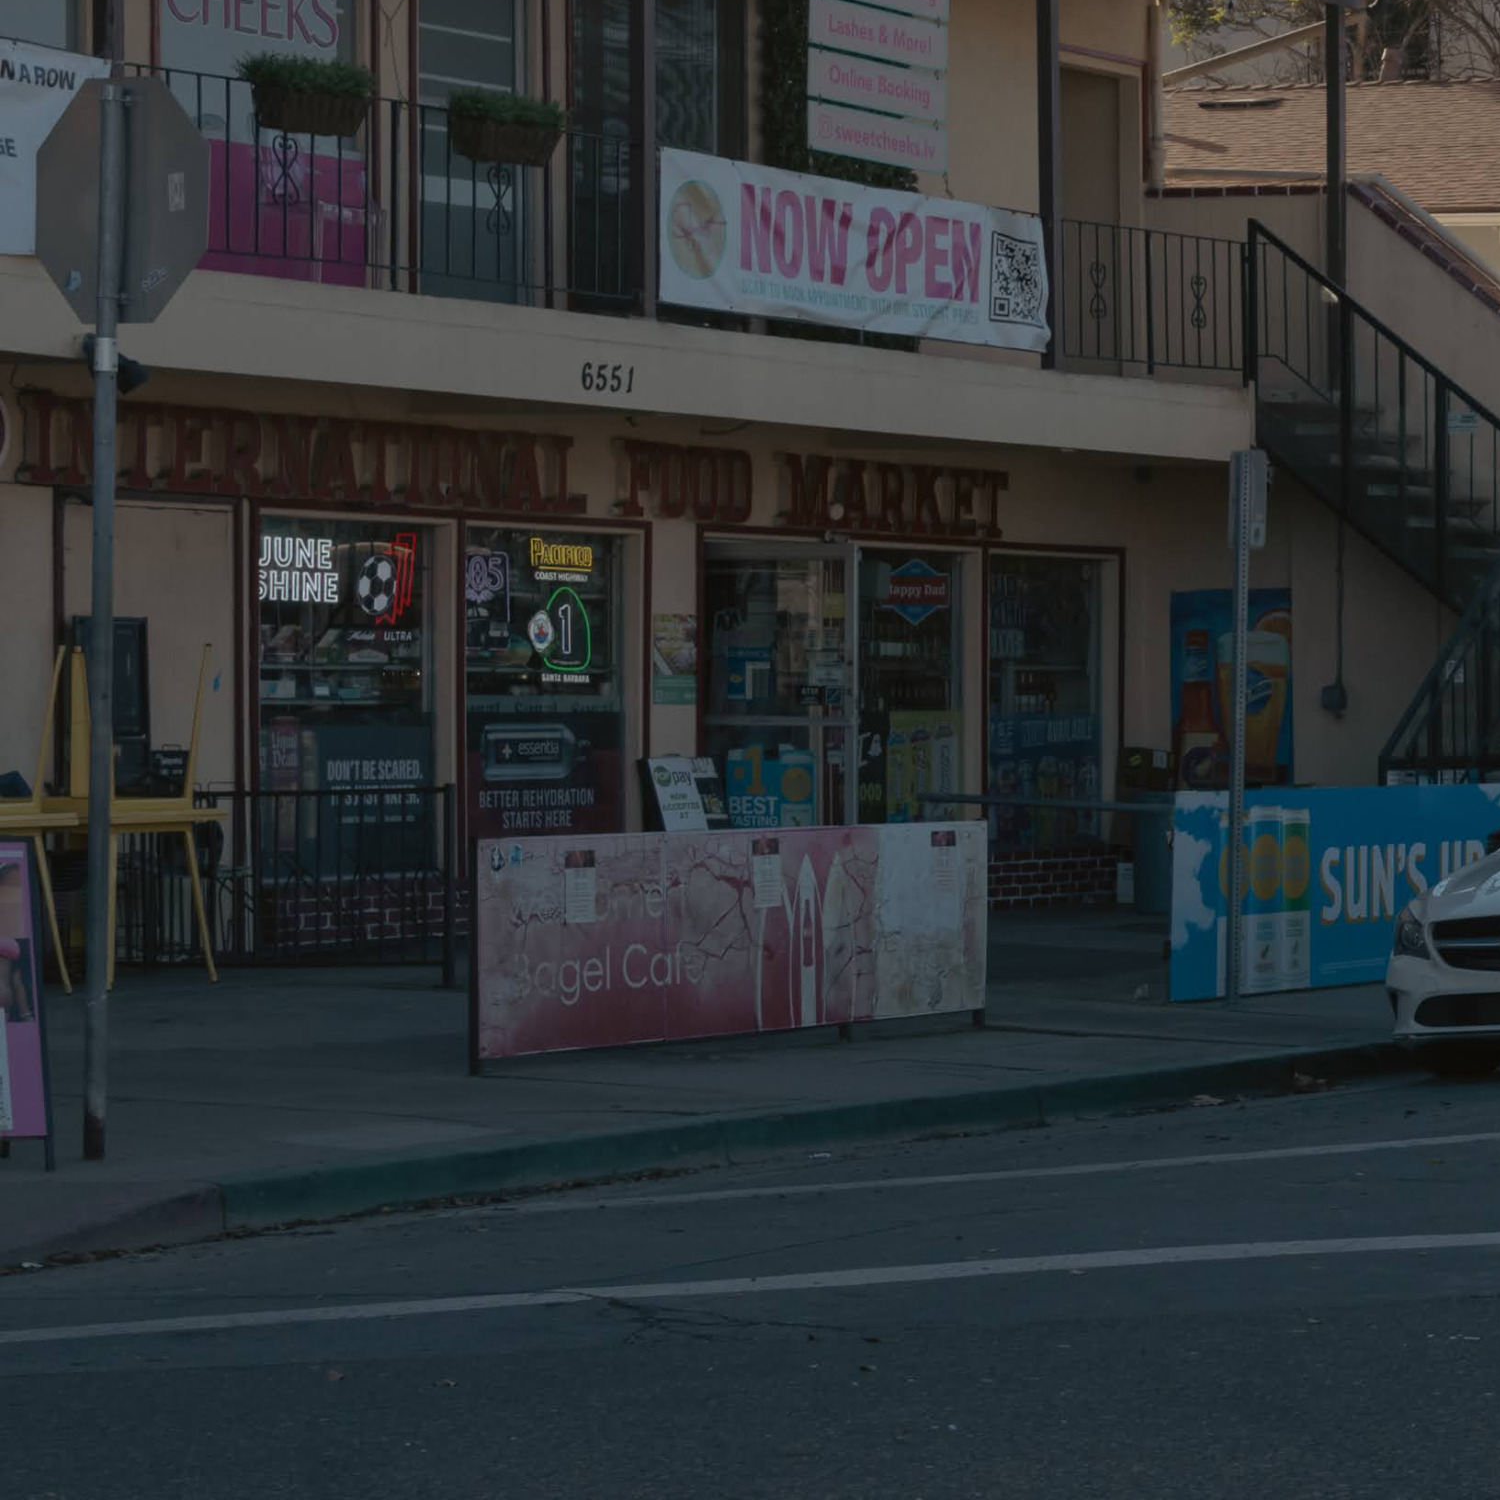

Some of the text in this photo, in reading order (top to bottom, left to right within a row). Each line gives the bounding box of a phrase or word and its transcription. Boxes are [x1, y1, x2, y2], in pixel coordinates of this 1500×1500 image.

[828, 13, 932, 56] Lashes & More!
[19, 63, 31, 84] A
[34, 65, 76, 90] ROW
[828, 64, 931, 109] Online Booking
[740, 182, 982, 304] NOW OPEN
[581, 362, 635, 393] 6551
[14, 393, 1009, 538] INTERNATIONAL FOOD MARKET
[258, 535, 334, 570] JUNE
[258, 570, 339, 604] SHINE
[466, 556, 504, 591] 05
[924, 583, 946, 595] Dad
[383, 630, 412, 641] ULTRA
[517, 741, 560, 755] essentia
[326, 757, 424, 782] DON'T BE SCARED.
[671, 770, 693, 787] pay
[479, 787, 595, 809] BETTER REHYDRATION
[728, 796, 779, 815] BEST
[502, 809, 574, 830] STARTS HERE
[1319, 841, 1430, 925] SUN'S
